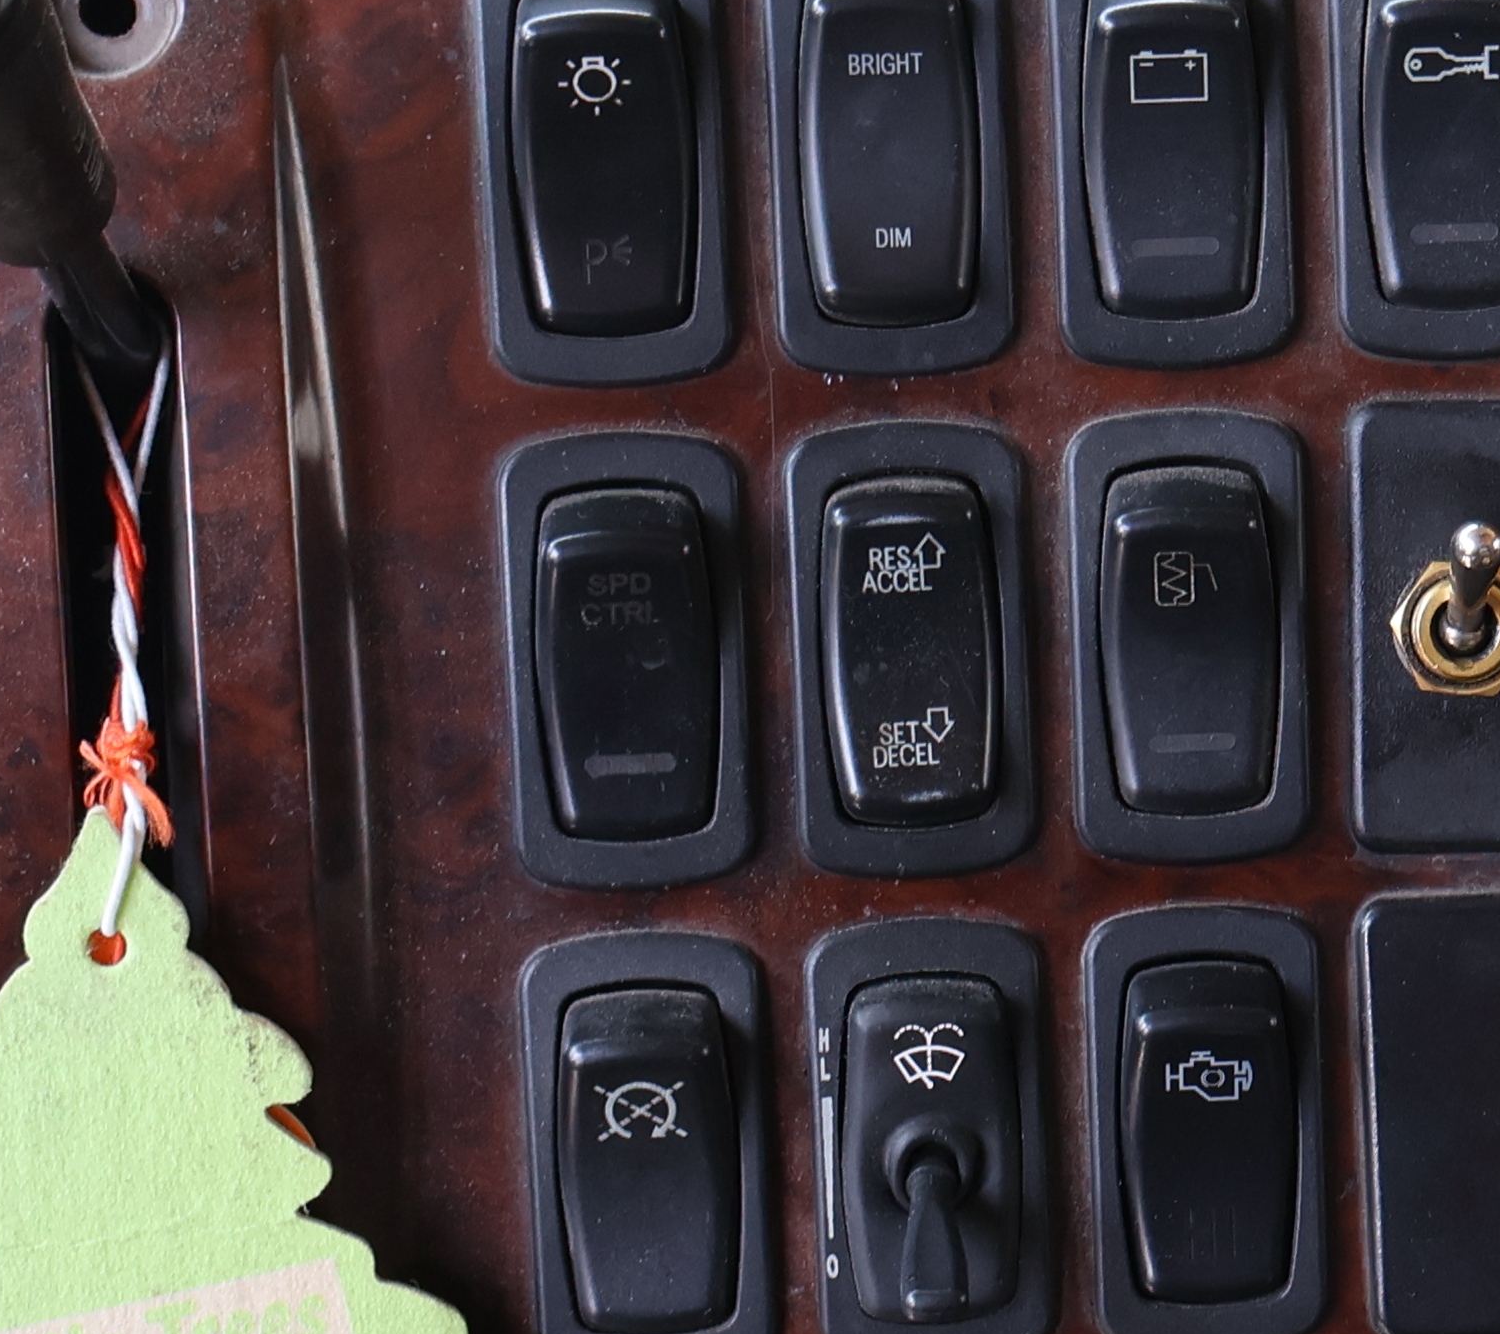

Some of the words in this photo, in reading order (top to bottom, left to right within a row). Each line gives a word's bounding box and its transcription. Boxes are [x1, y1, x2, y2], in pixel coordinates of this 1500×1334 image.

[847, 51, 924, 77] BRIGHT
[874, 226, 913, 249] DIM
[586, 571, 653, 597] SPD
[861, 566, 933, 595] ACCEL
[580, 601, 660, 627] CTRL
[878, 720, 920, 746] SET
[871, 741, 941, 770] DECEL
[817, 1026, 831, 1054] H
[819, 1055, 832, 1083] L
